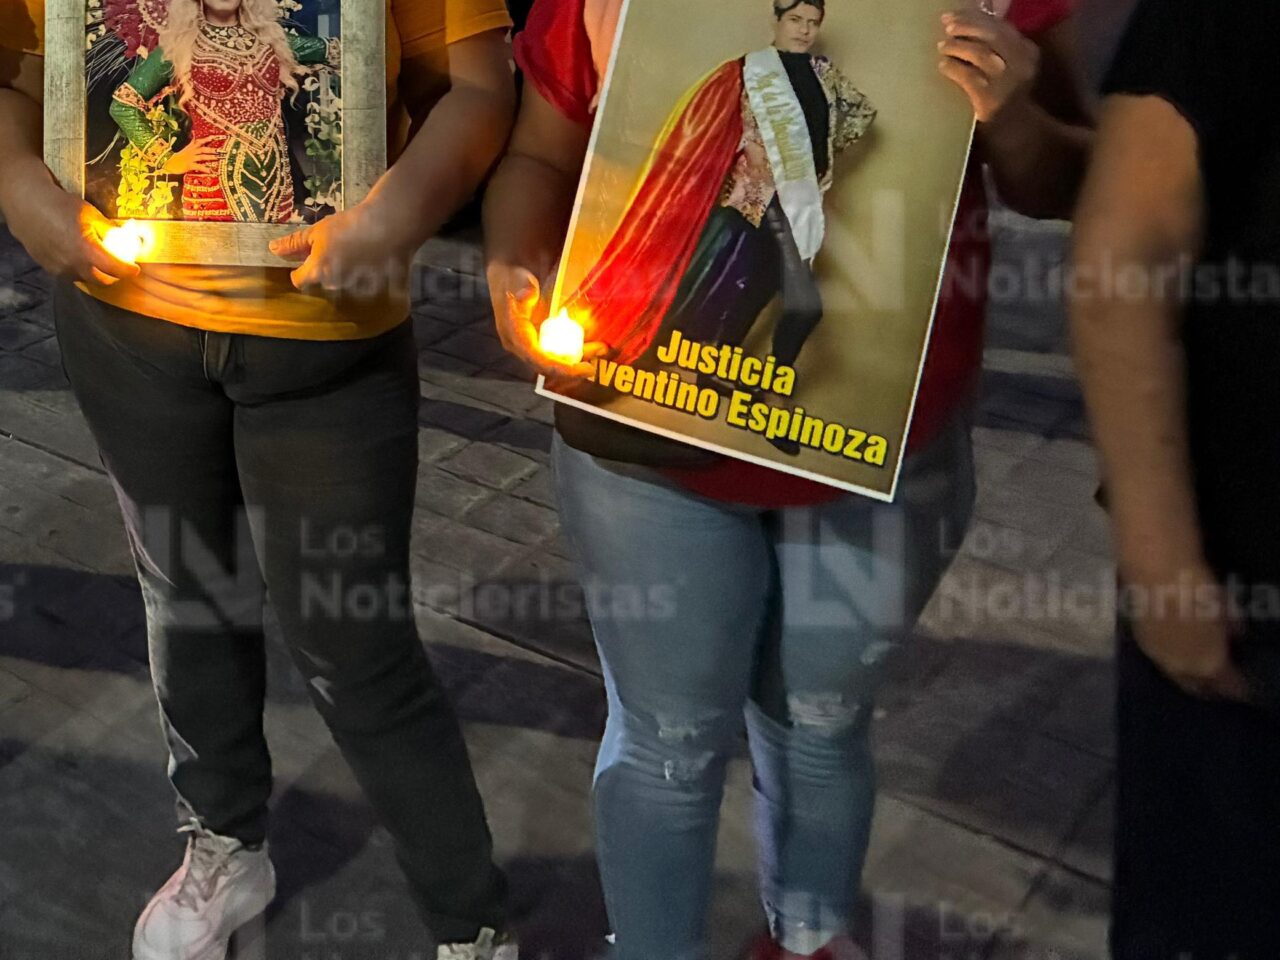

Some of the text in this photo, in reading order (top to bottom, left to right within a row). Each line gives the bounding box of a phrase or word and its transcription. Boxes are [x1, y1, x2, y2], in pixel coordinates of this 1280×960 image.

[657, 329, 796, 397] Justicia
[587, 357, 888, 467] ventino Espinoza
